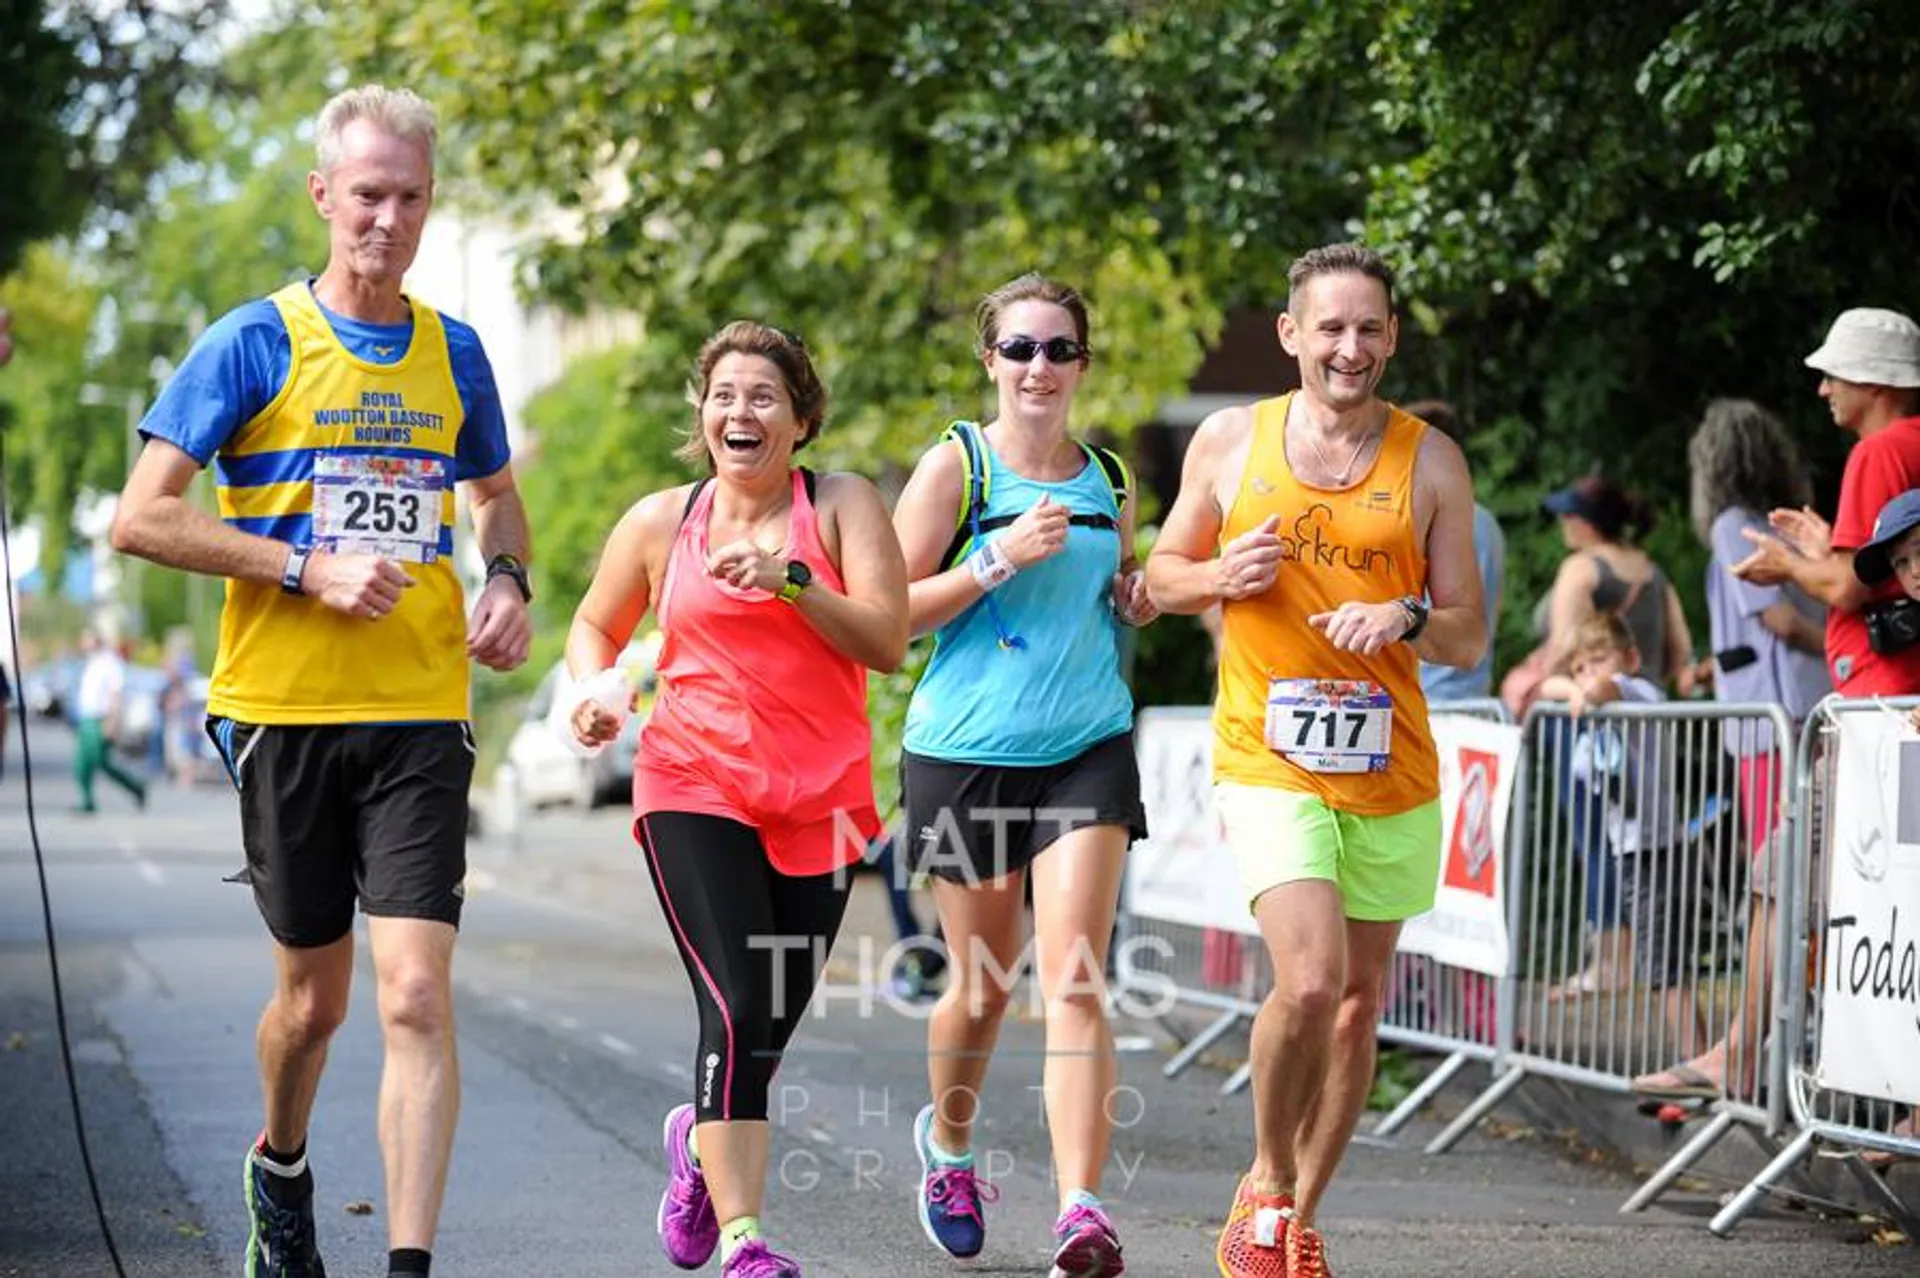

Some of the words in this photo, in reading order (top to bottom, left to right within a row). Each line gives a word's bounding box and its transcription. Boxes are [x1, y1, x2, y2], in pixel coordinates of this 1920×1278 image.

[361, 391, 403, 408] ROYAL
[314, 409, 386, 426] WOOTTON
[389, 409, 444, 432] BASSETT
[354, 426, 412, 444] HOUNDS
[343, 490, 420, 534] 253
[1279, 525, 1391, 578] arkrun
[1292, 710, 1367, 748] 717
[1829, 904, 1920, 1035] Toda
